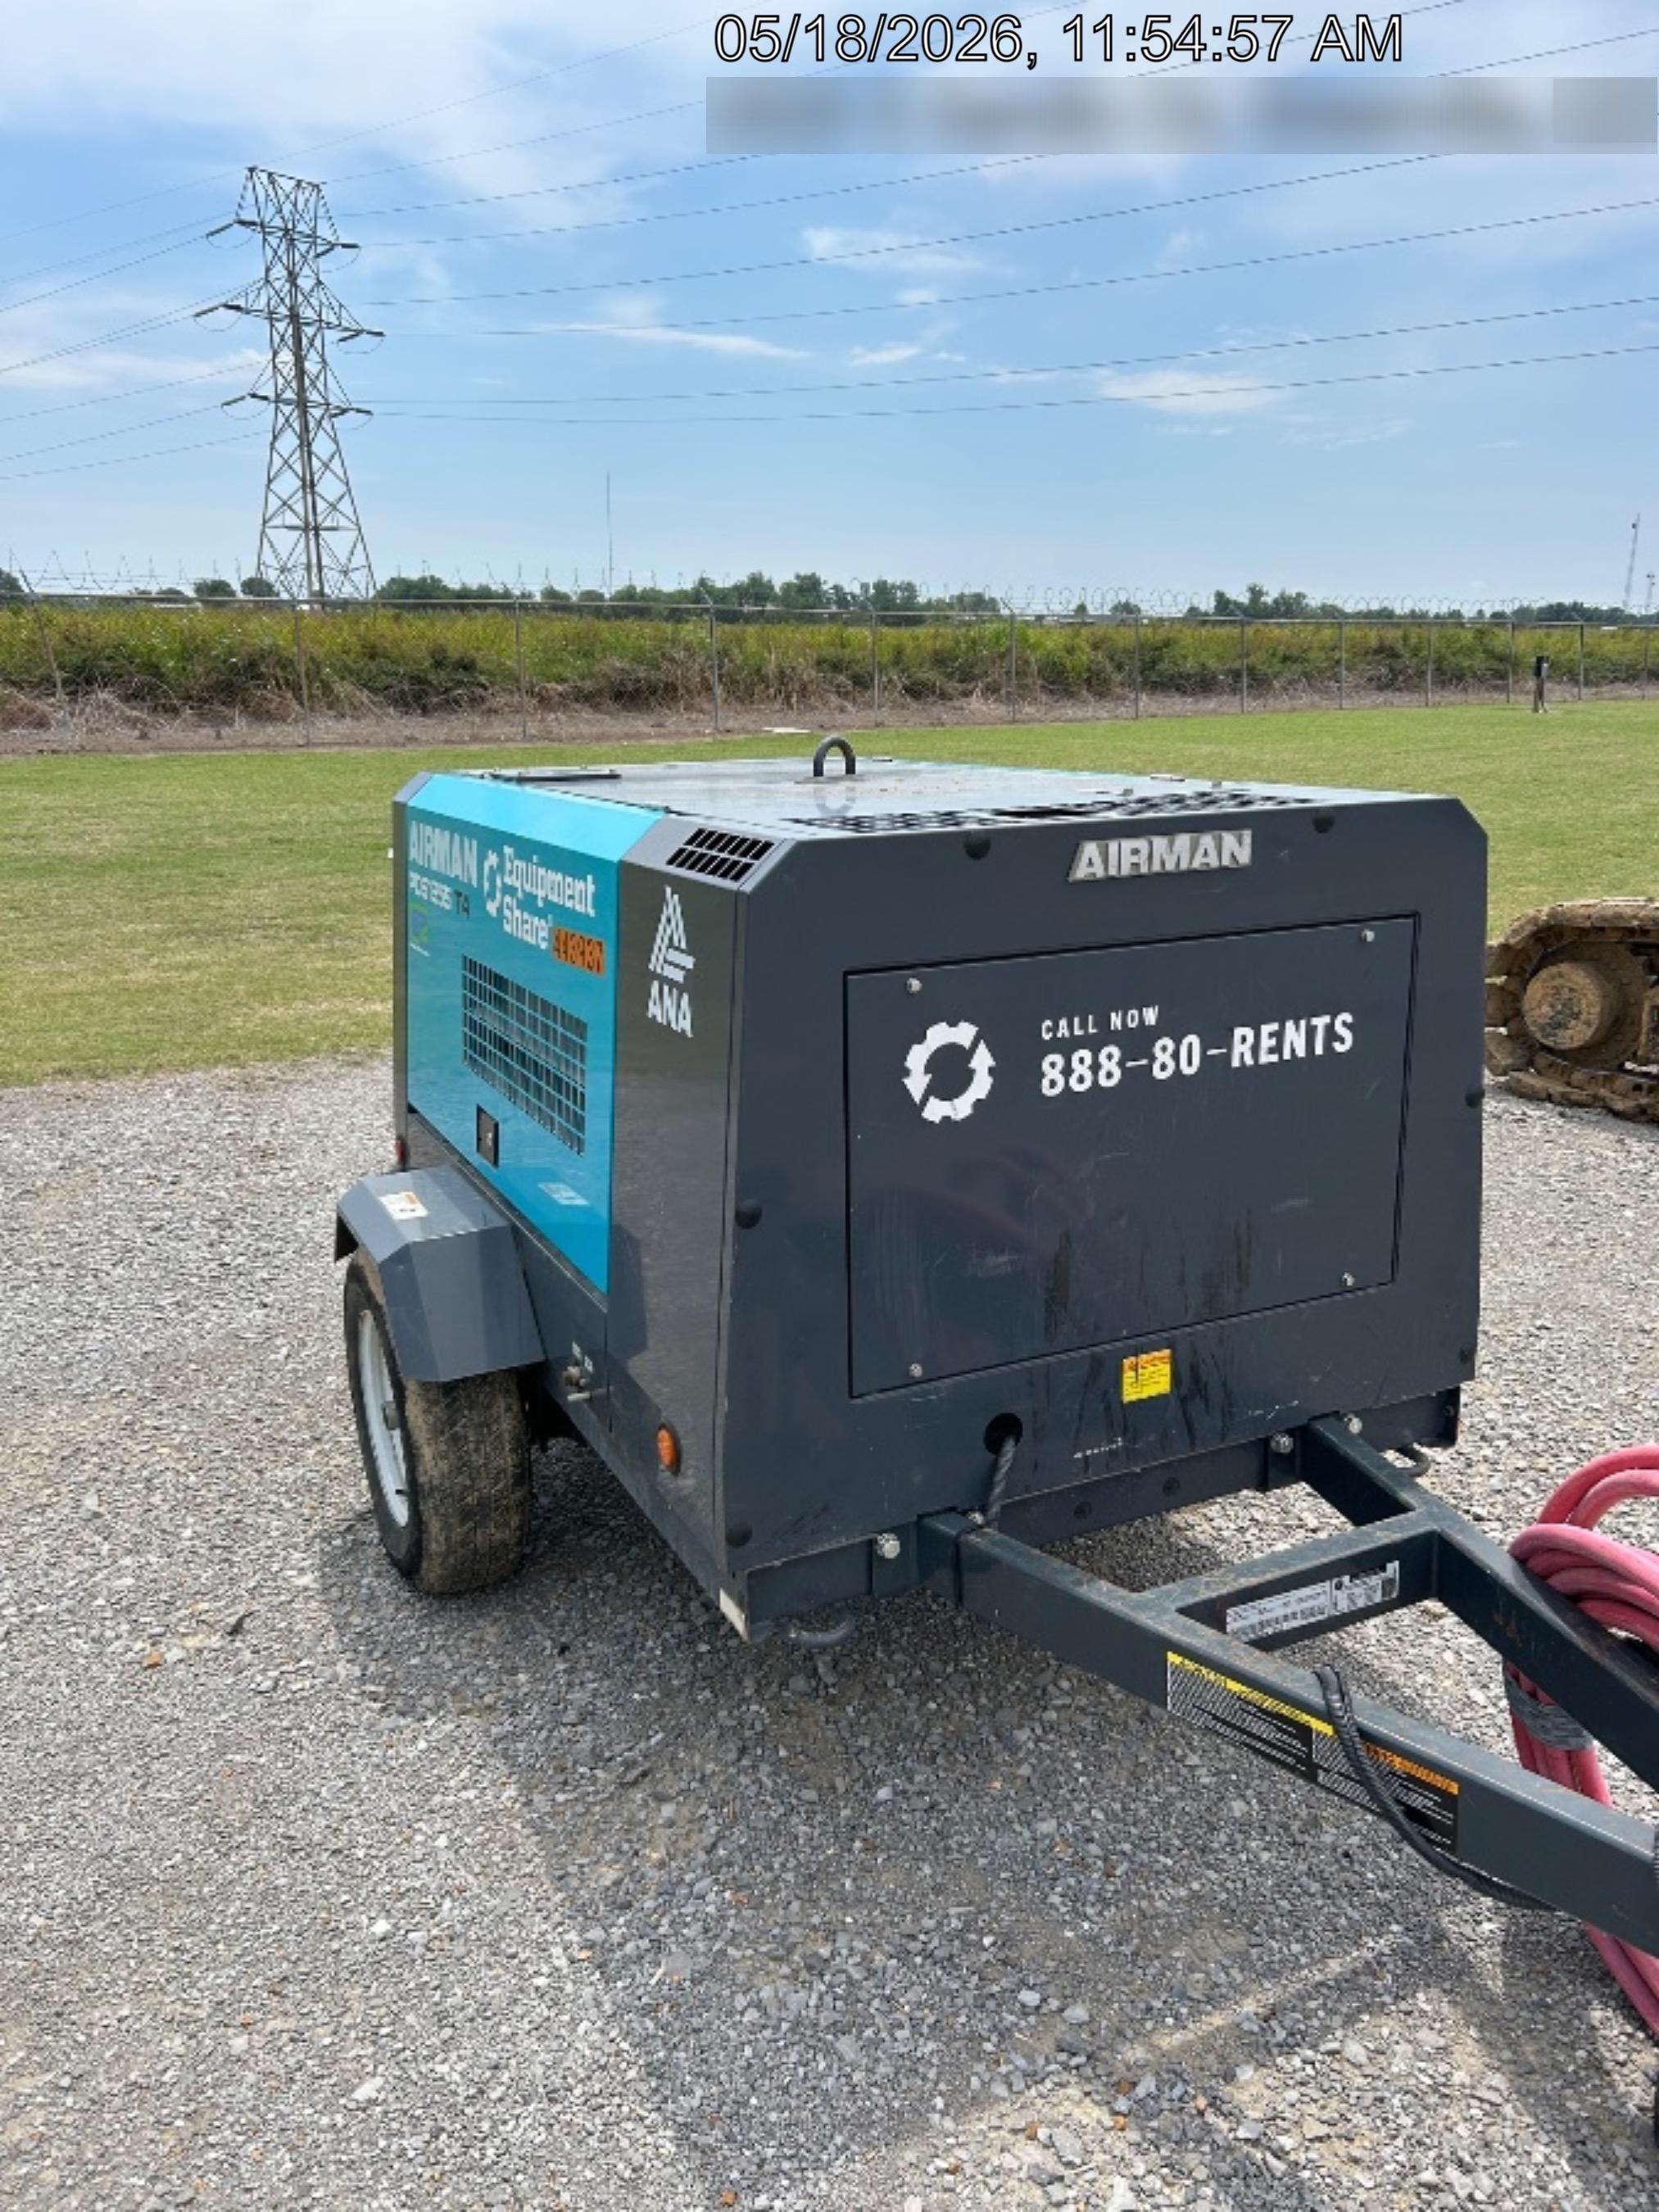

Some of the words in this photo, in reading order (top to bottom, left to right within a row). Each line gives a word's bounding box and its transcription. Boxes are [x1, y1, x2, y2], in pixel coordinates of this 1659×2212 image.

[409, 821, 478, 888] AIRMAN
[503, 845, 596, 918] Equipment
[1068, 829, 1253, 882] AIRMAN
[646, 980, 694, 1039] ANA
[1040, 1018, 1099, 1041] CALL
[1109, 1004, 1159, 1031] NOW
[1040, 1011, 1354, 1098] 888-80-RENTS
